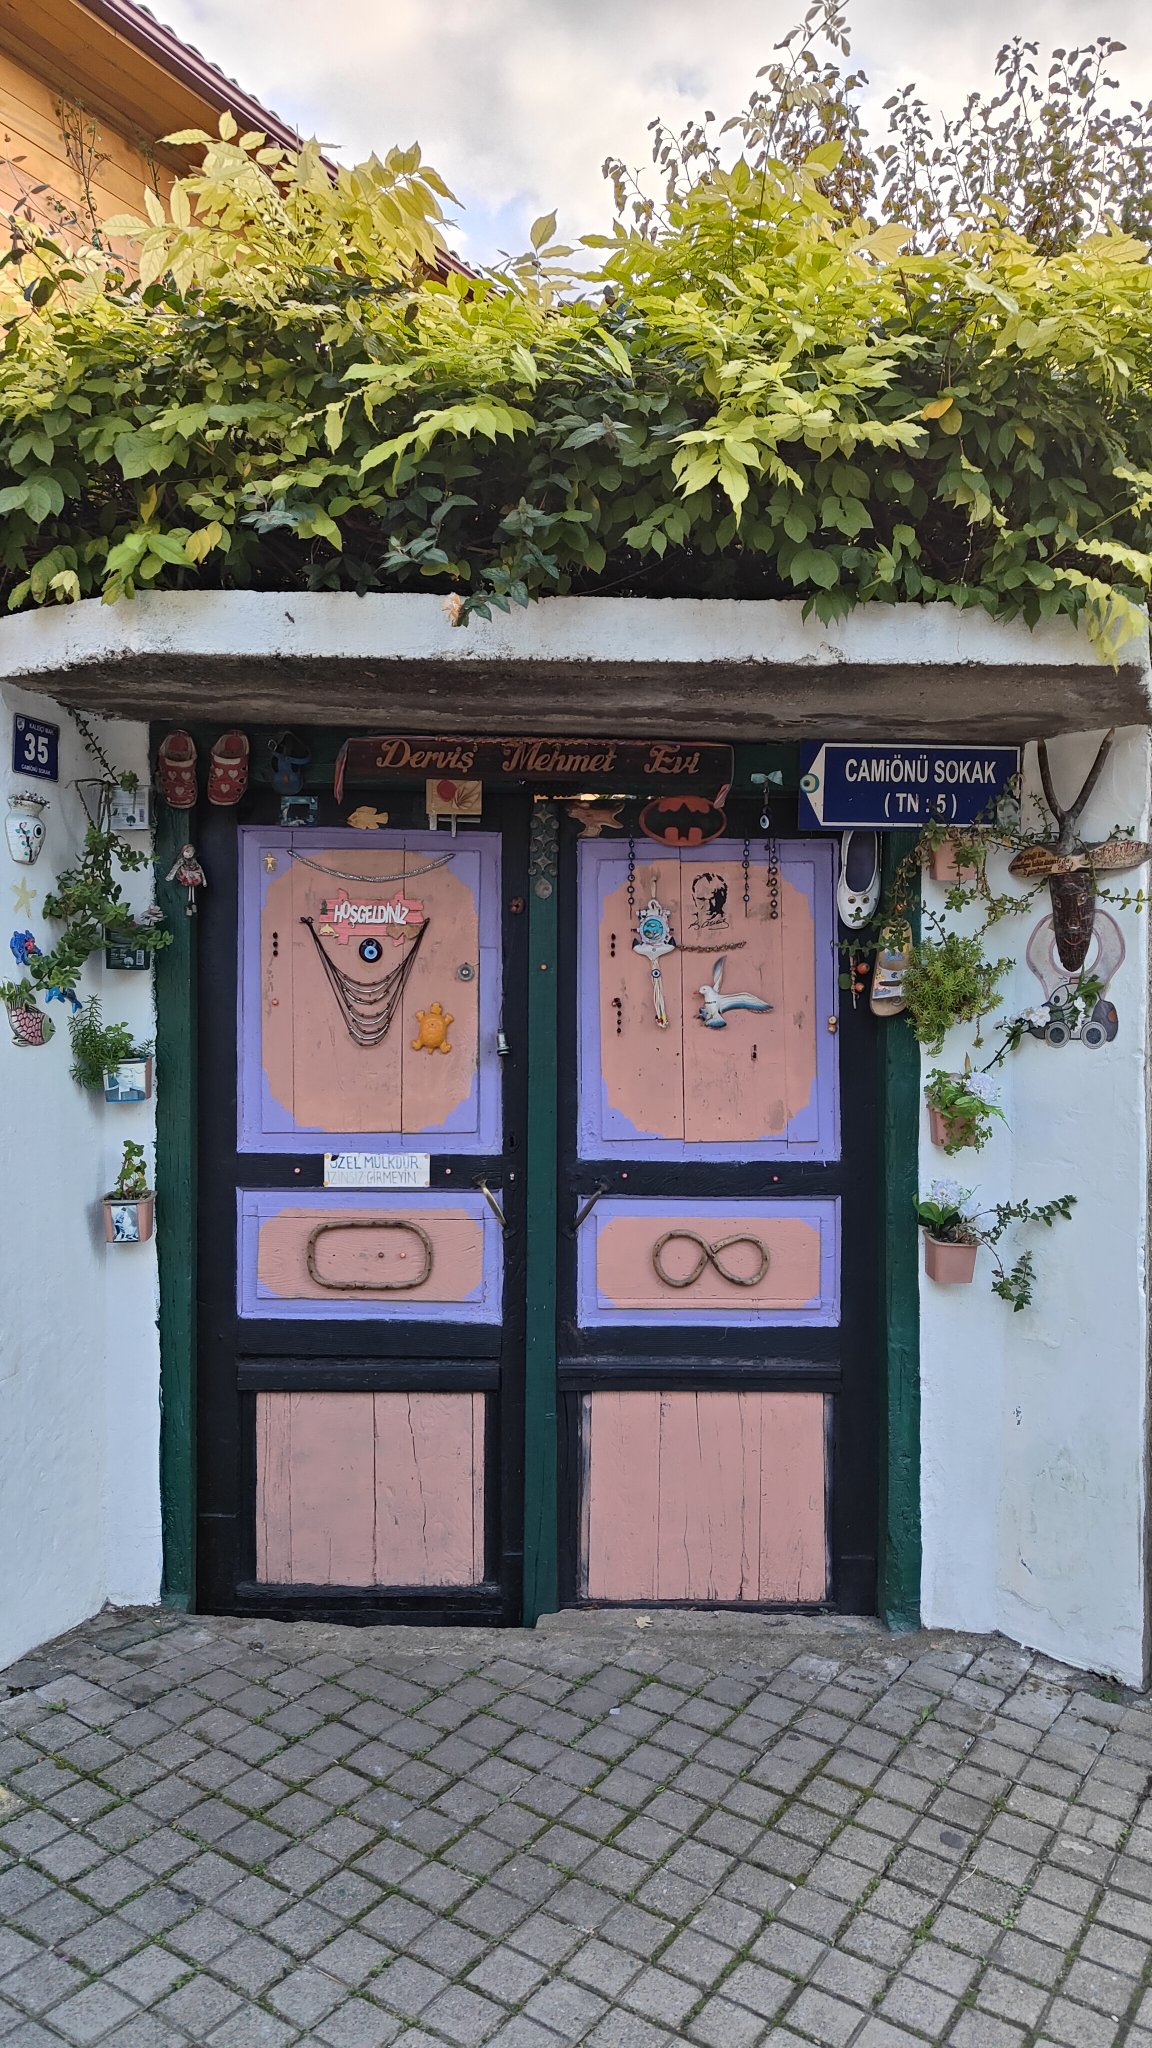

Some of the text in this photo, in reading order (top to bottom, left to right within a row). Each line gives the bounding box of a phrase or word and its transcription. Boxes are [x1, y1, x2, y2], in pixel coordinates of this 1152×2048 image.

[24, 732, 49, 764] 35
[376, 738, 700, 774] Derviş Mehmet Evi
[933, 759, 996, 784] SOKAK
